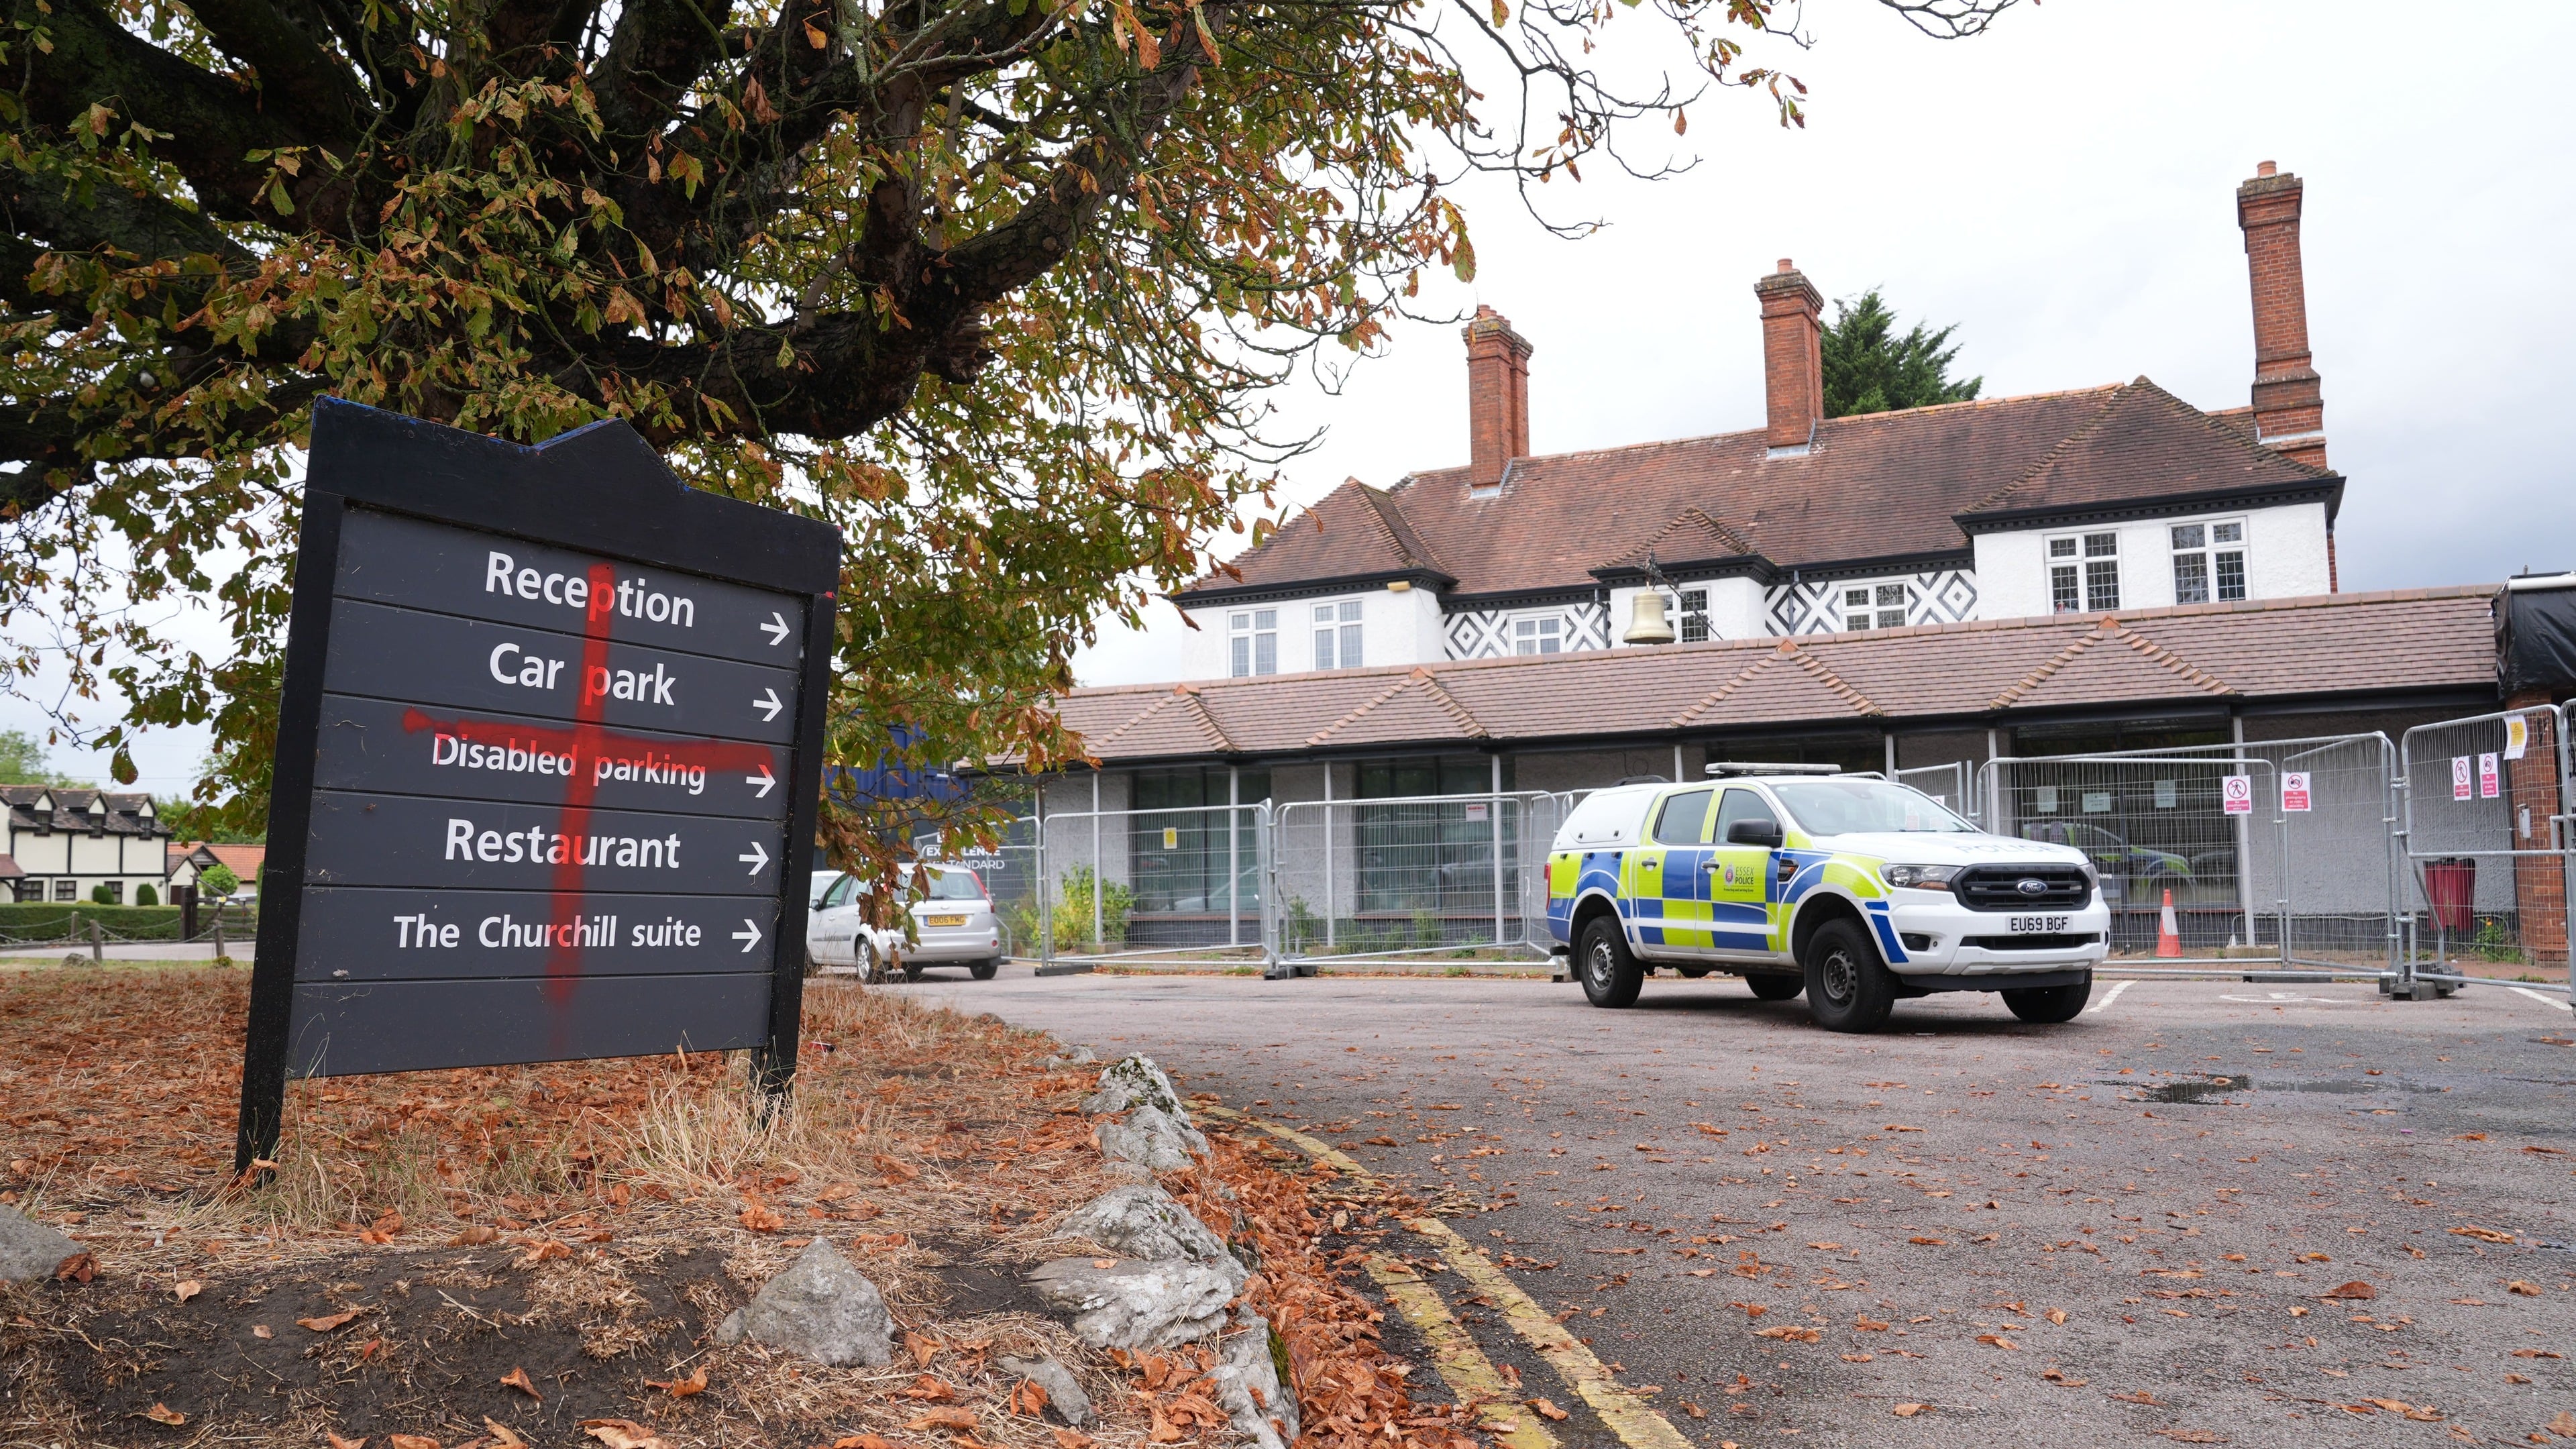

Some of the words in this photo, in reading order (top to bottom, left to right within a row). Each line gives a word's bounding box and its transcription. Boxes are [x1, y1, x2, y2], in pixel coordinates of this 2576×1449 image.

[485, 551, 694, 628] Reception
[489, 643, 565, 690] Car
[584, 663, 676, 706] park
[432, 733, 578, 776] Disabled
[592, 751, 706, 796] parking
[445, 818, 681, 869] Restaurant
[1955, 844, 2062, 853] POLICE
[926, 847, 1001, 856] EXLENE
[1735, 866, 1754, 876] ESSEX
[1735, 876, 1754, 885] POLICE
[2026, 881, 2042, 892] Ford
[2010, 917, 2043, 931] EU69
[2047, 916, 2068, 930] BGF
[393, 914, 460, 949] The
[478, 914, 617, 949] Churchill
[631, 916, 702, 947] suite
